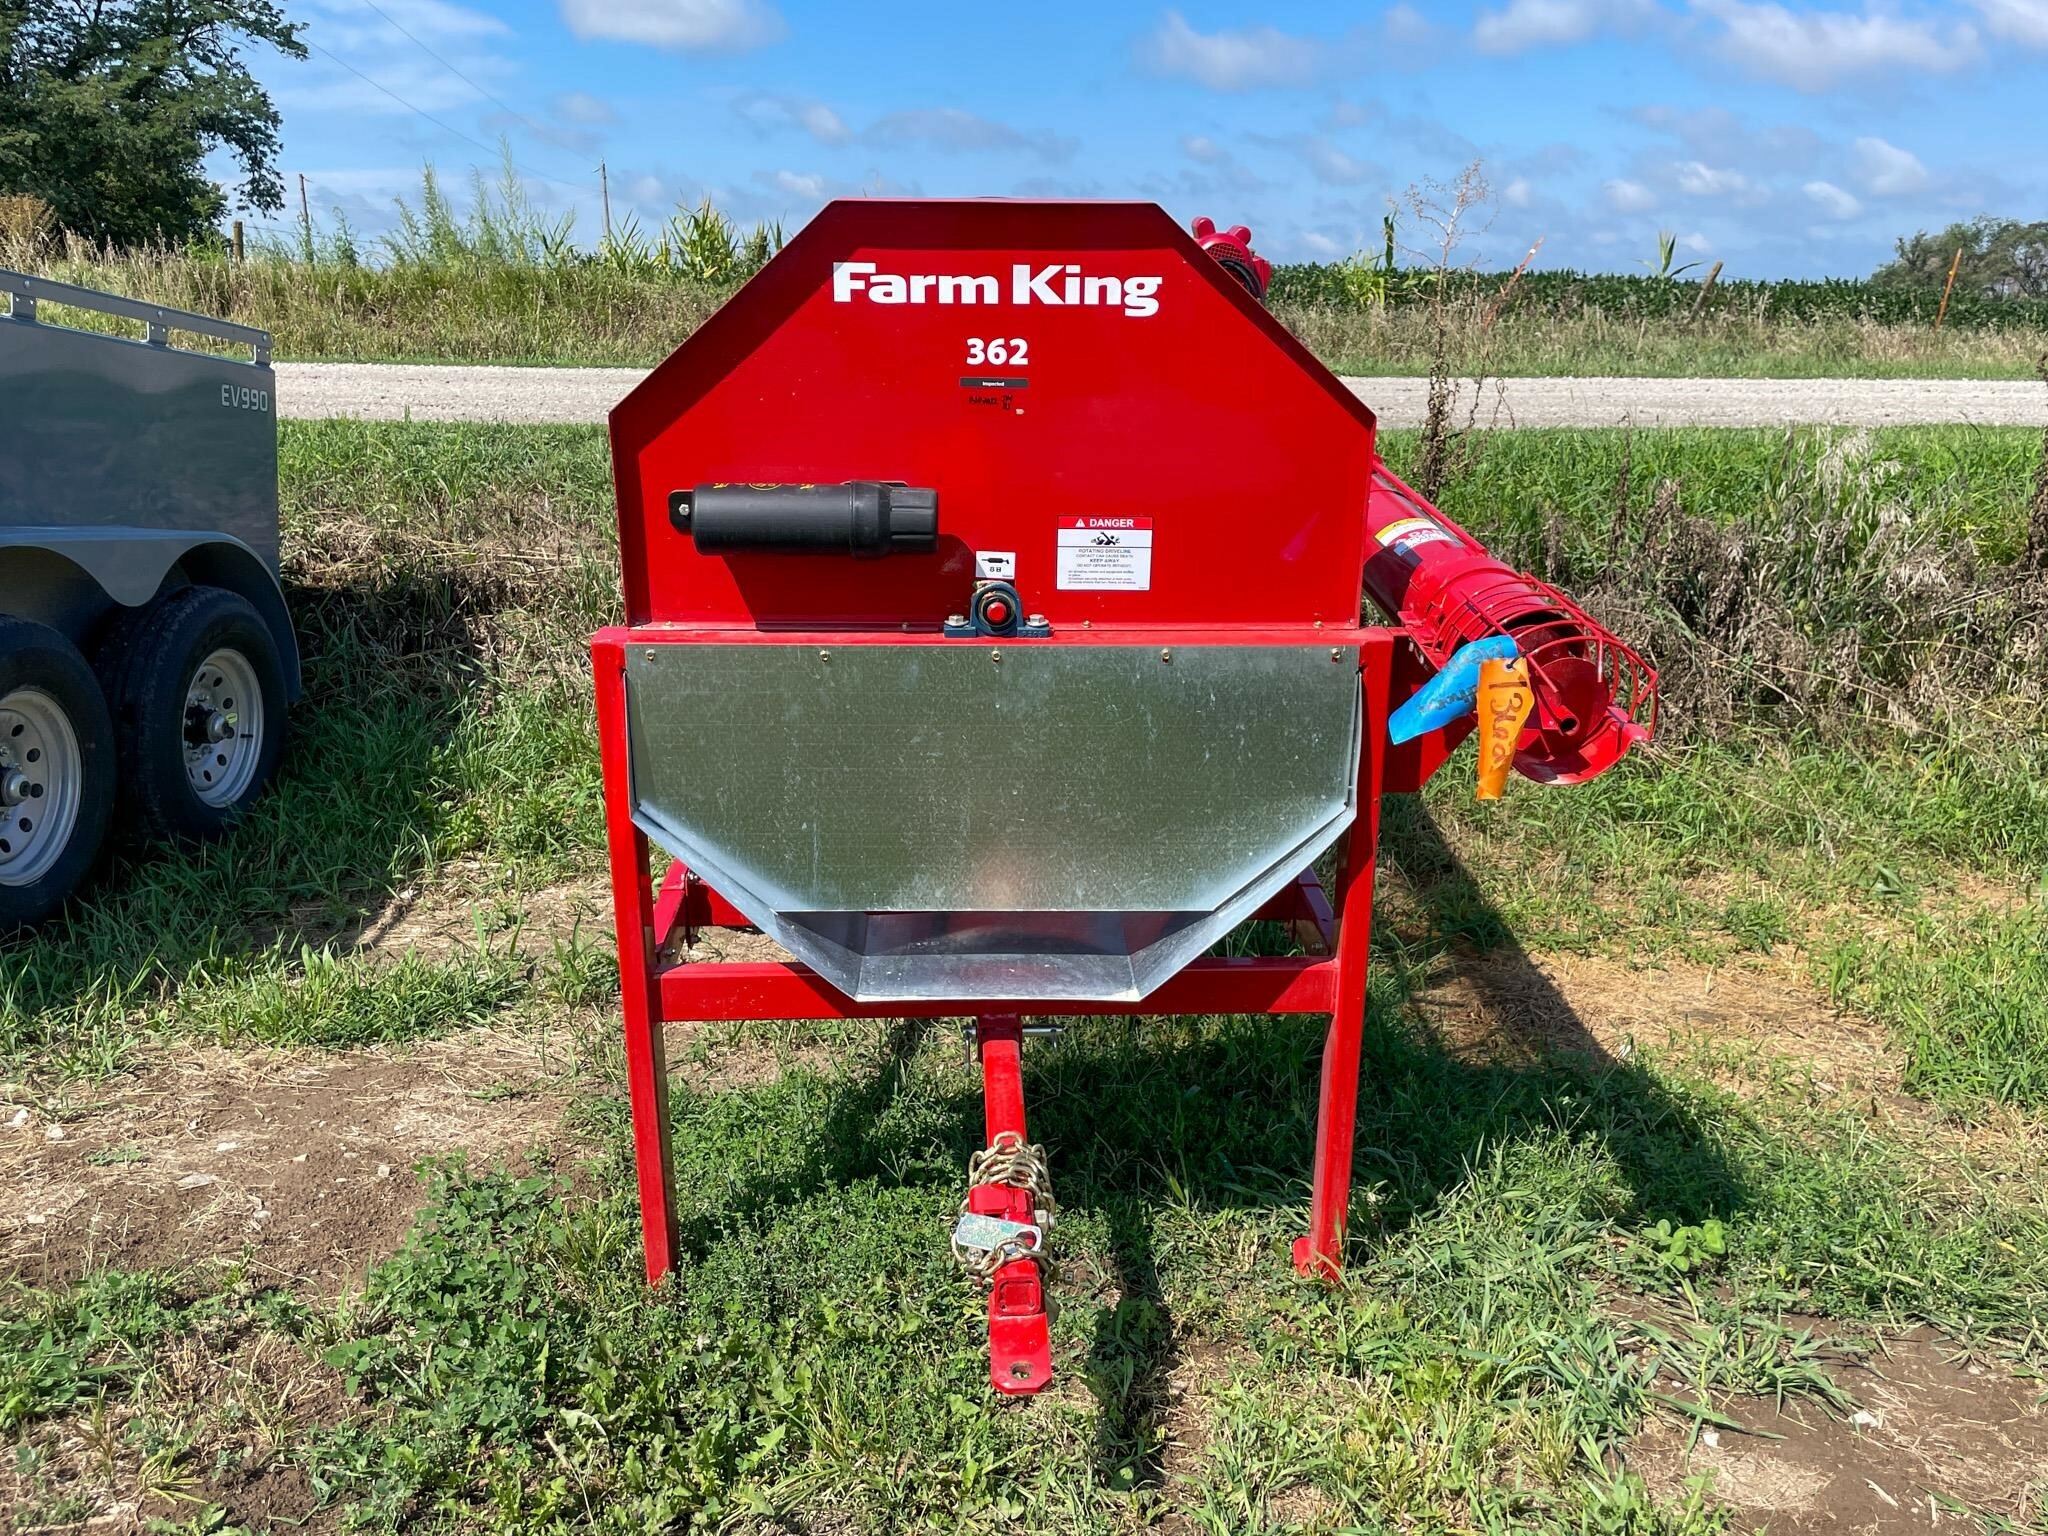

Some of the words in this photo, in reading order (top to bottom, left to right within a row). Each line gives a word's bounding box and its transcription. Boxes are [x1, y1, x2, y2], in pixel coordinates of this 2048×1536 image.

[833, 262, 999, 304] Farm
[1012, 264, 1163, 317] King
[966, 337, 1029, 366] 362
[221, 384, 268, 412] EV990
[1089, 518, 1134, 528] DANGER
